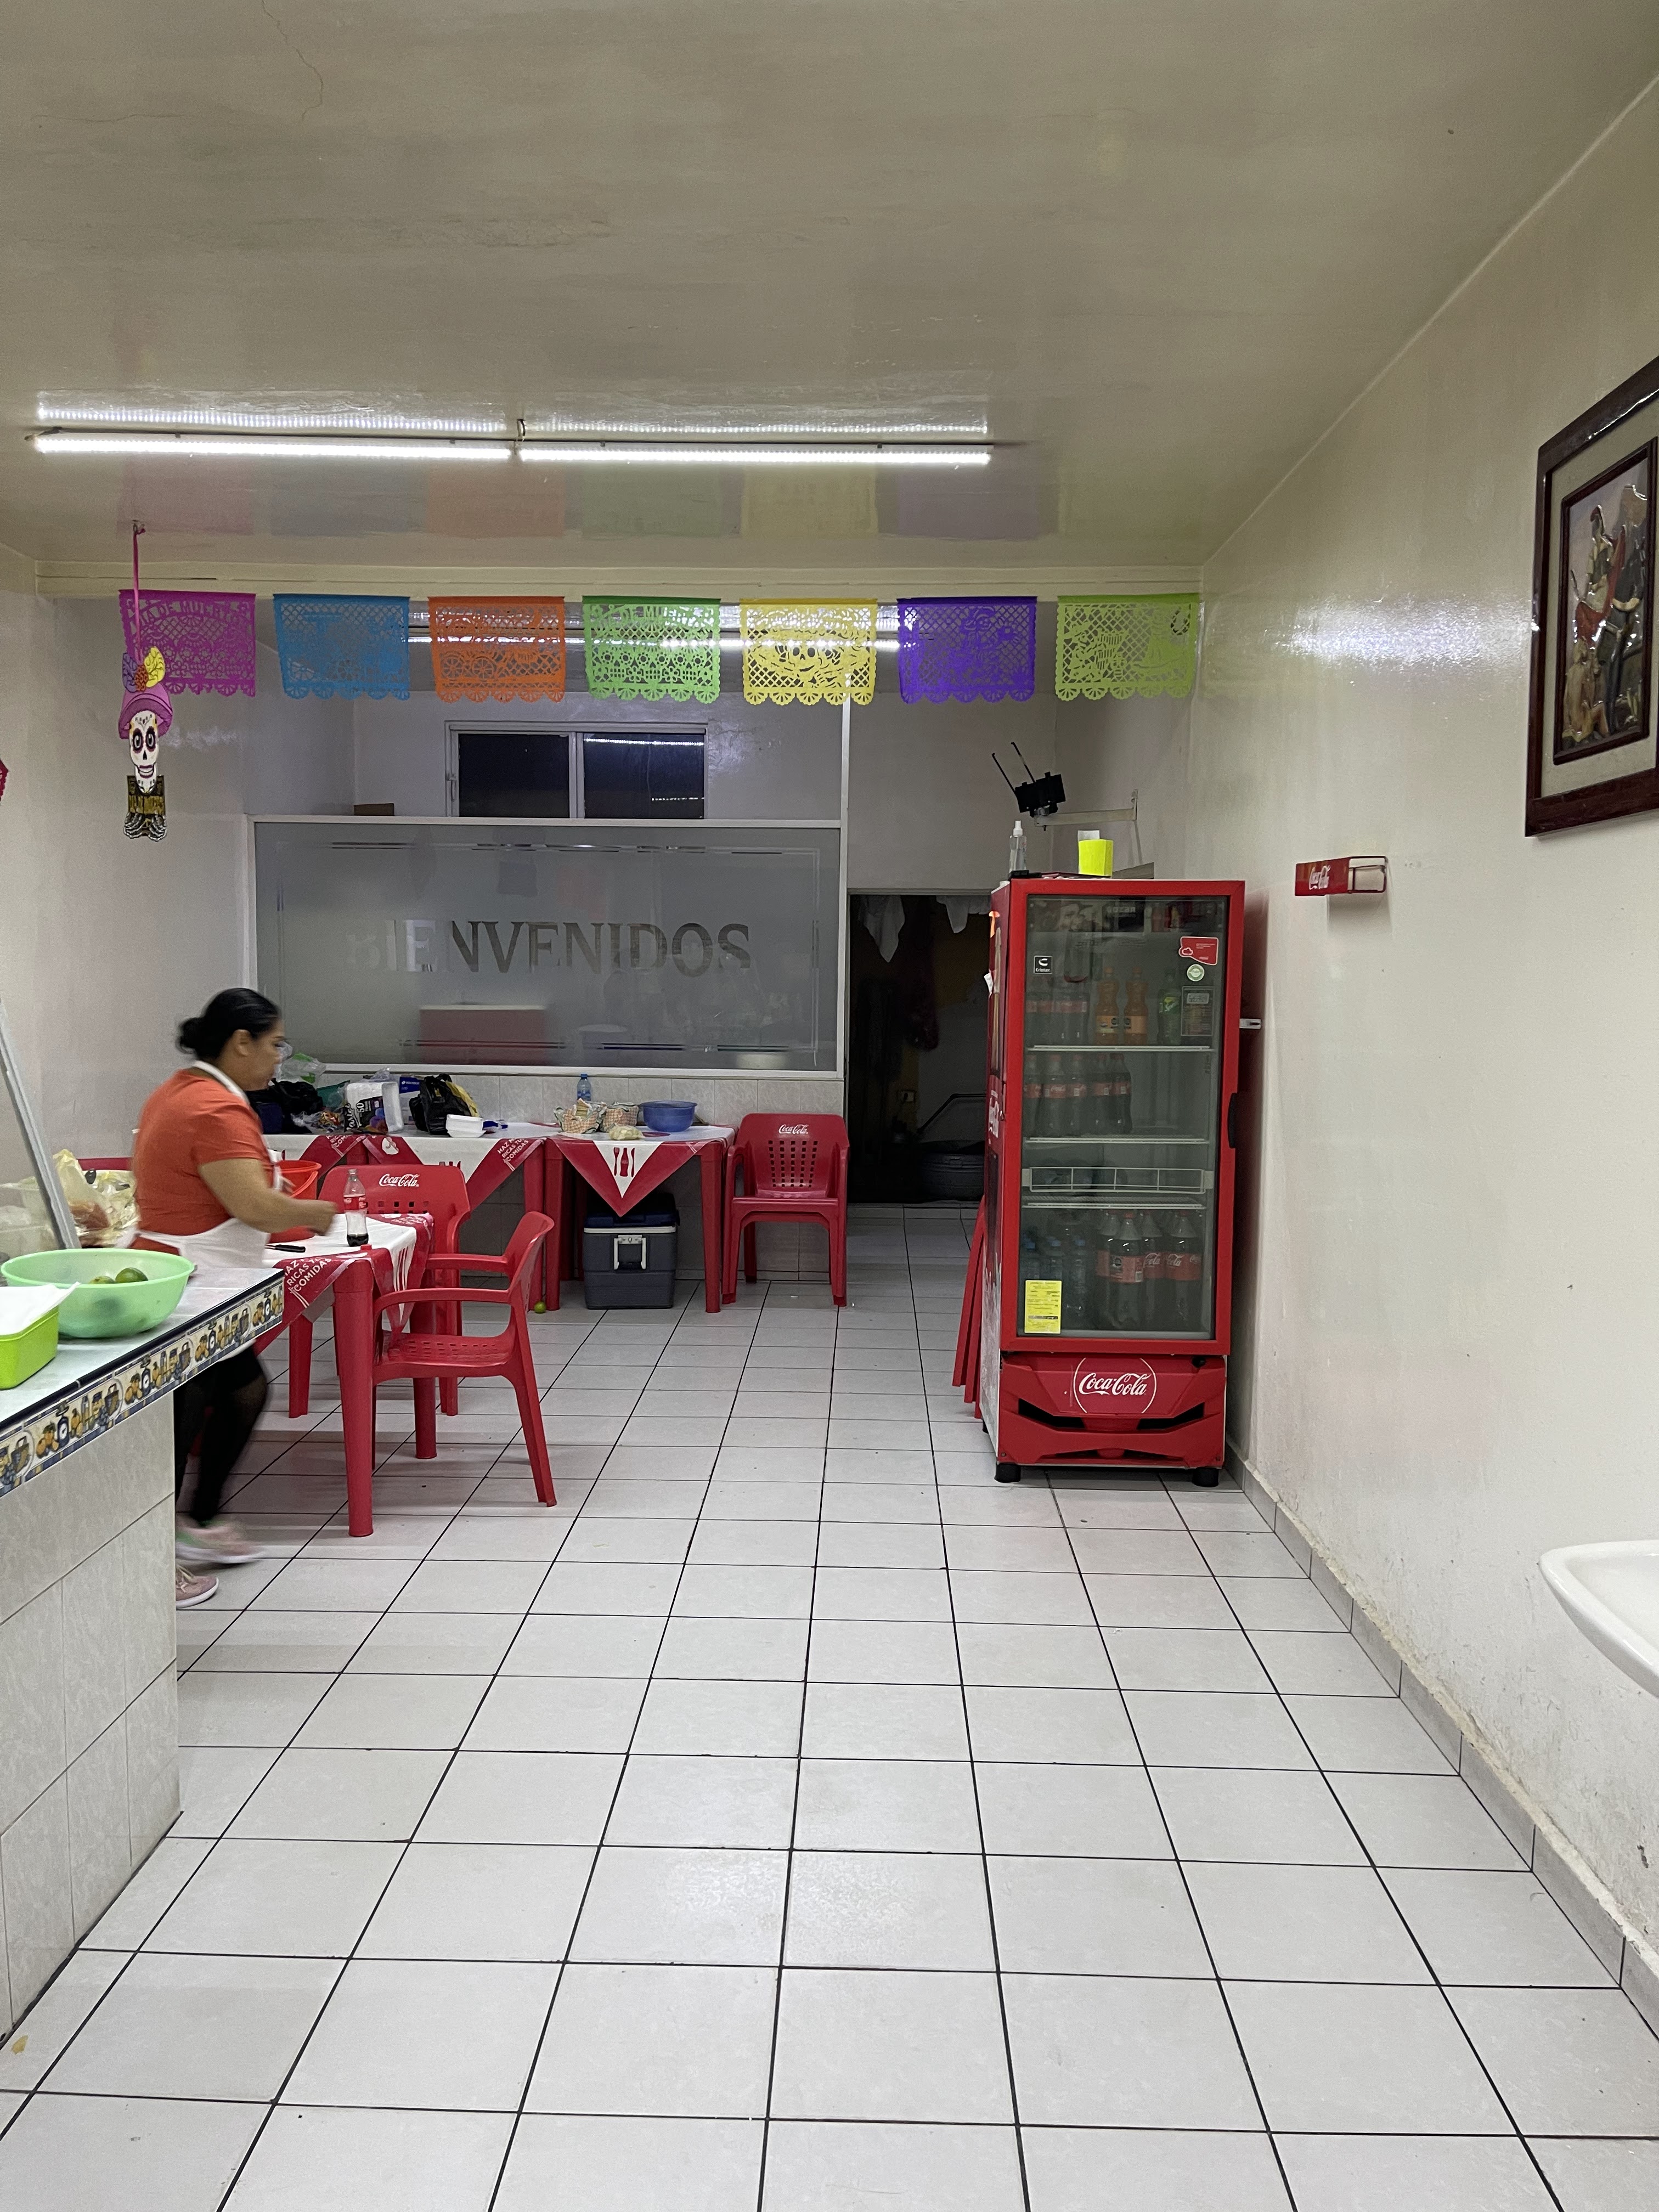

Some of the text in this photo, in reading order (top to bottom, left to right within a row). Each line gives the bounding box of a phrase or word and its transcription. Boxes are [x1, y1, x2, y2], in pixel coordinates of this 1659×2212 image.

[346, 919, 751, 978] BIENVENIDOS
[356, 1102, 365, 1114] 50
[778, 1124, 809, 1135] Coca-Cola
[497, 1142, 510, 1154] HAZ
[501, 1144, 516, 1158] RICAS
[506, 1139, 529, 1162] COMIDAS
[379, 1173, 420, 1188] Coca-Cola
[285, 1260, 300, 1276] AZ
[286, 1263, 309, 1286] RICAS
[294, 1259, 332, 1292] COMIDAS
[1078, 1372, 1152, 1396] Coca-Cola
